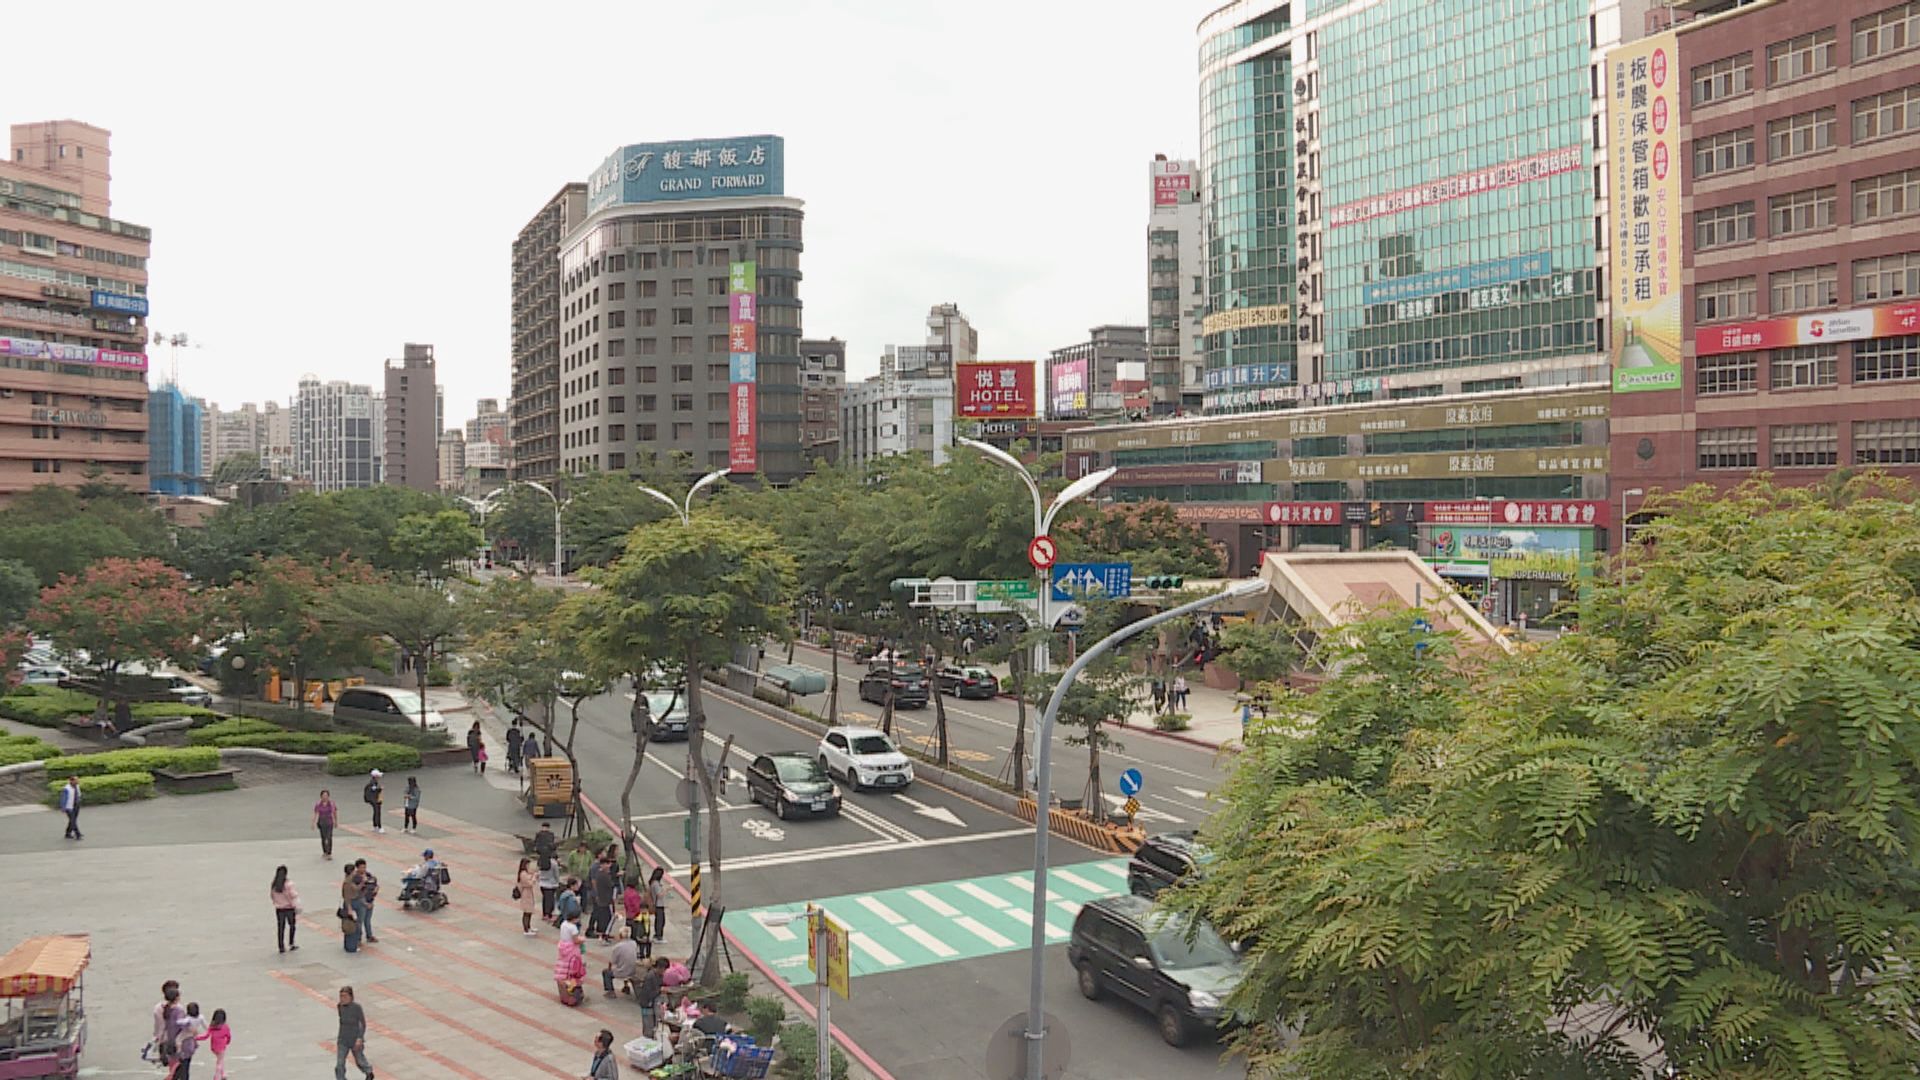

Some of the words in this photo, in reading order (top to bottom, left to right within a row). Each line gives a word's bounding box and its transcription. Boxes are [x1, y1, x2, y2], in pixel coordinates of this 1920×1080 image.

[661, 145, 765, 169] 馥都飯店
[660, 177, 702, 192] GRAND
[711, 174, 764, 189] FORWARD
[1630, 57, 1652, 303] 板農保管箱歡迎承租
[1901, 316, 1917, 327] 4F
[975, 368, 1016, 389] 悅喜
[971, 389, 1024, 402] HOTEL
[982, 423, 1016, 434] HOTEL
